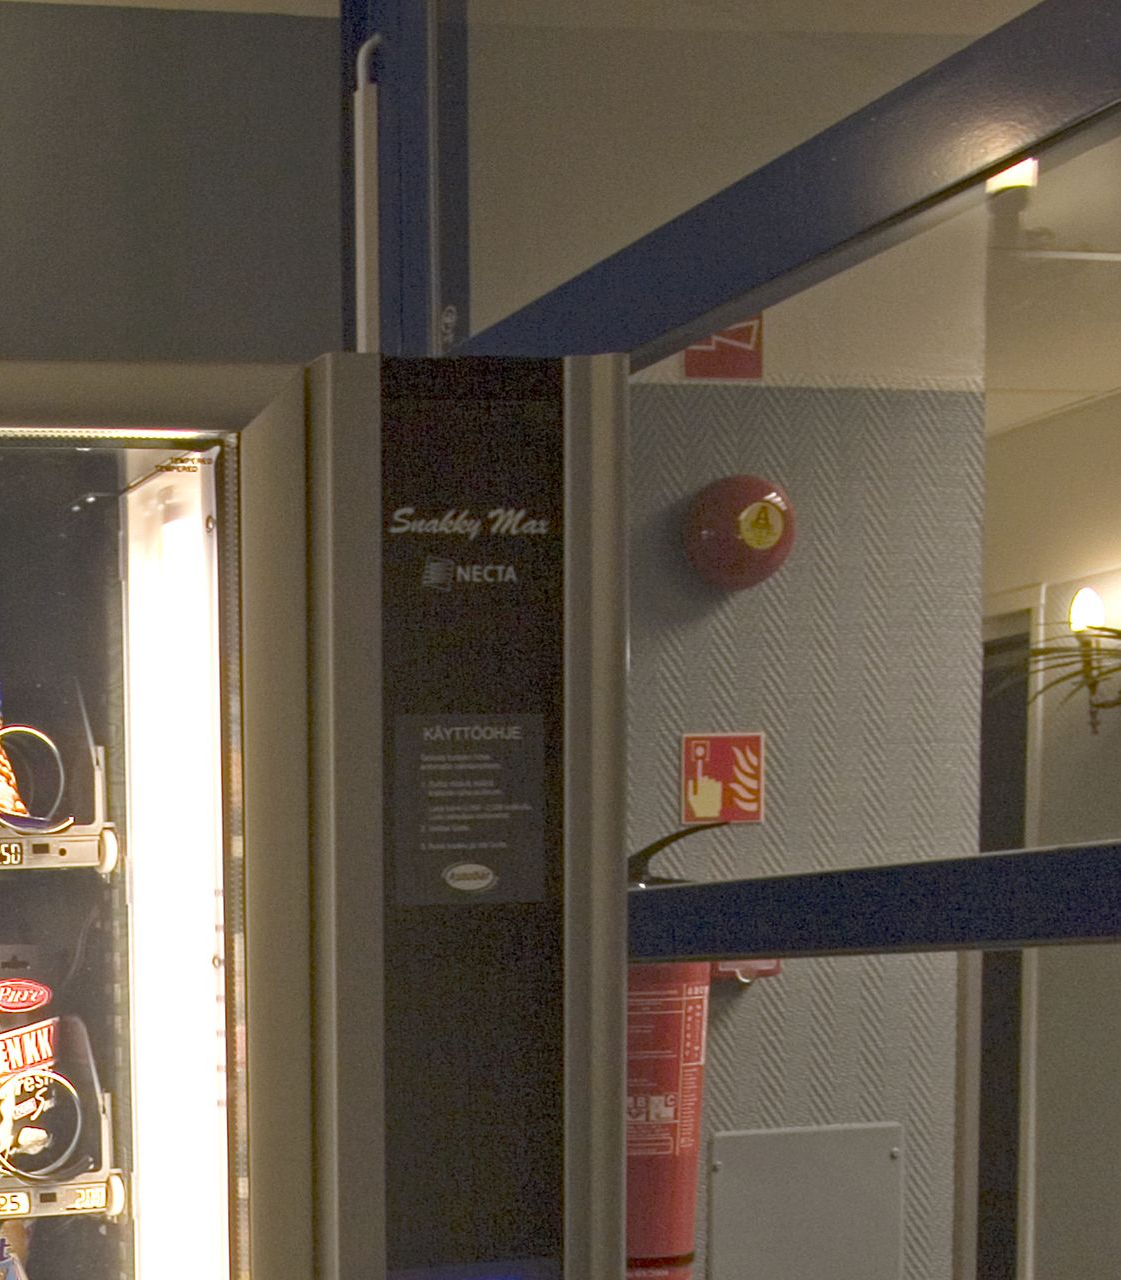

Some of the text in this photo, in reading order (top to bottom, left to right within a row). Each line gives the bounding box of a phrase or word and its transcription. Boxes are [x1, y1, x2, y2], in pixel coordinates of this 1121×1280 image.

[389, 507, 550, 540] Snakky Max
[456, 564, 518, 584] NECTA
